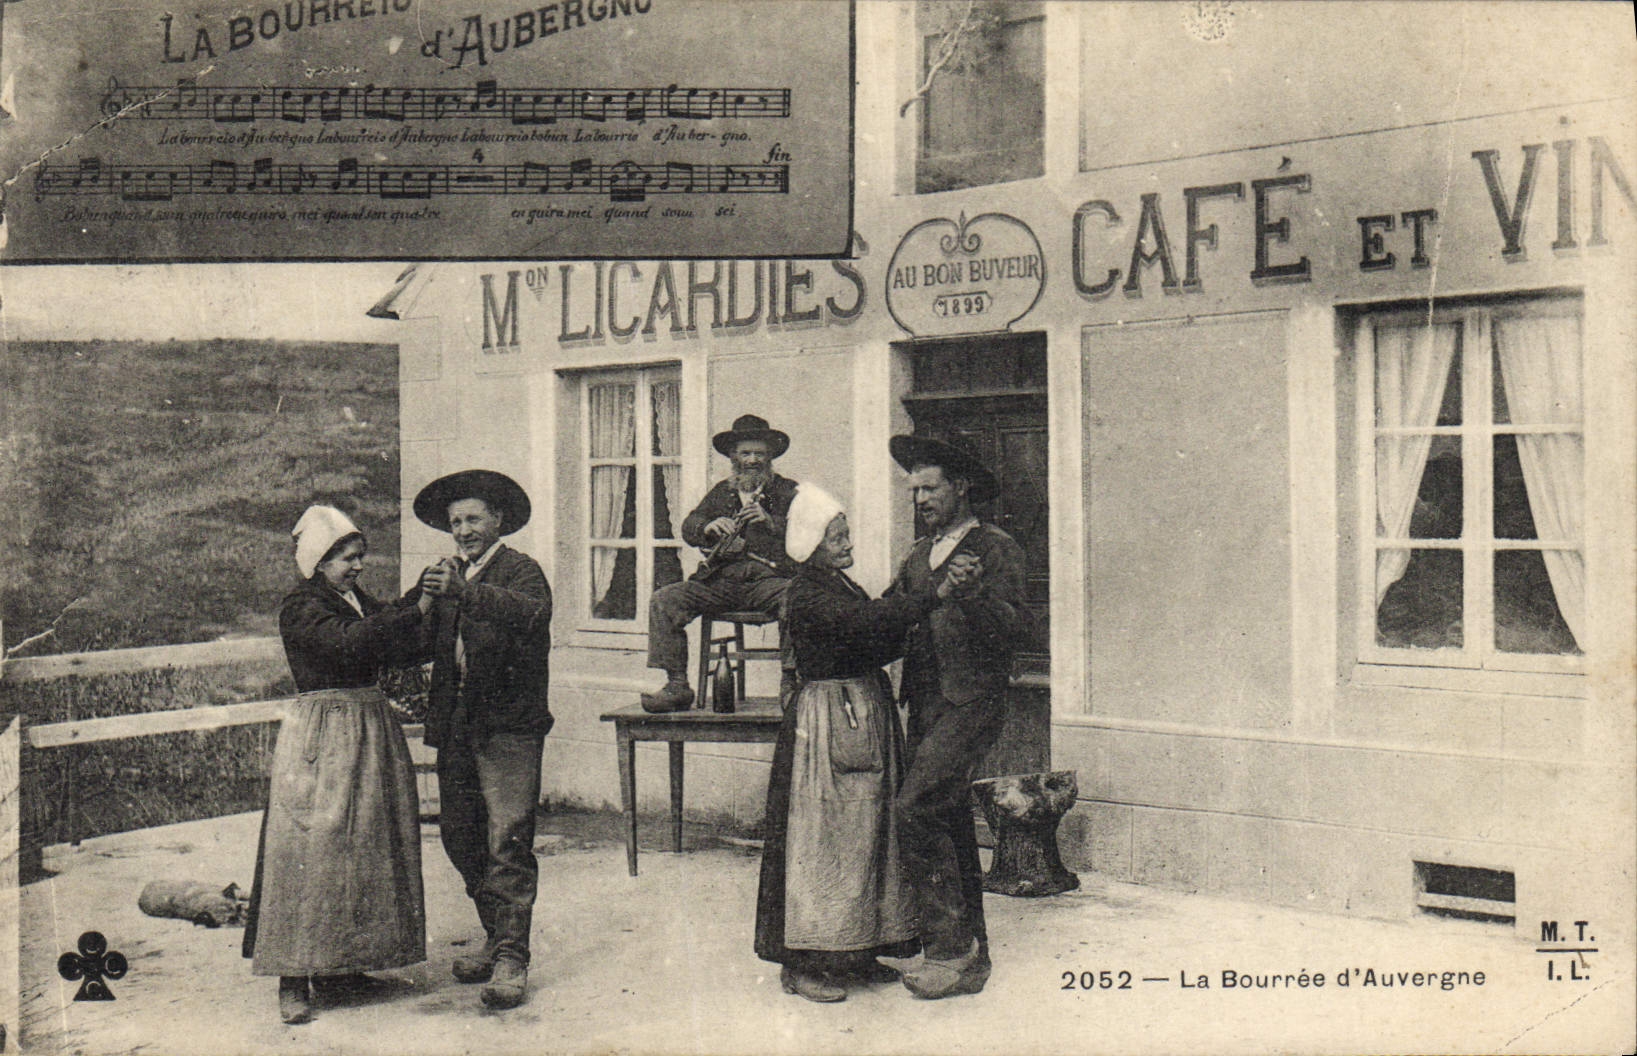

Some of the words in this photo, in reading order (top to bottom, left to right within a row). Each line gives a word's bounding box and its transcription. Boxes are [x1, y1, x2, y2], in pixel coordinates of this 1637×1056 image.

[1072, 157, 1311, 300] CAFÉ
[1356, 208, 1438, 271] ET
[557, 236, 868, 346] LICARDIES
[893, 266, 917, 289] AU
[923, 263, 962, 287] BON
[968, 254, 1041, 283] BUVEUR
[937, 295, 985, 317] 1899
